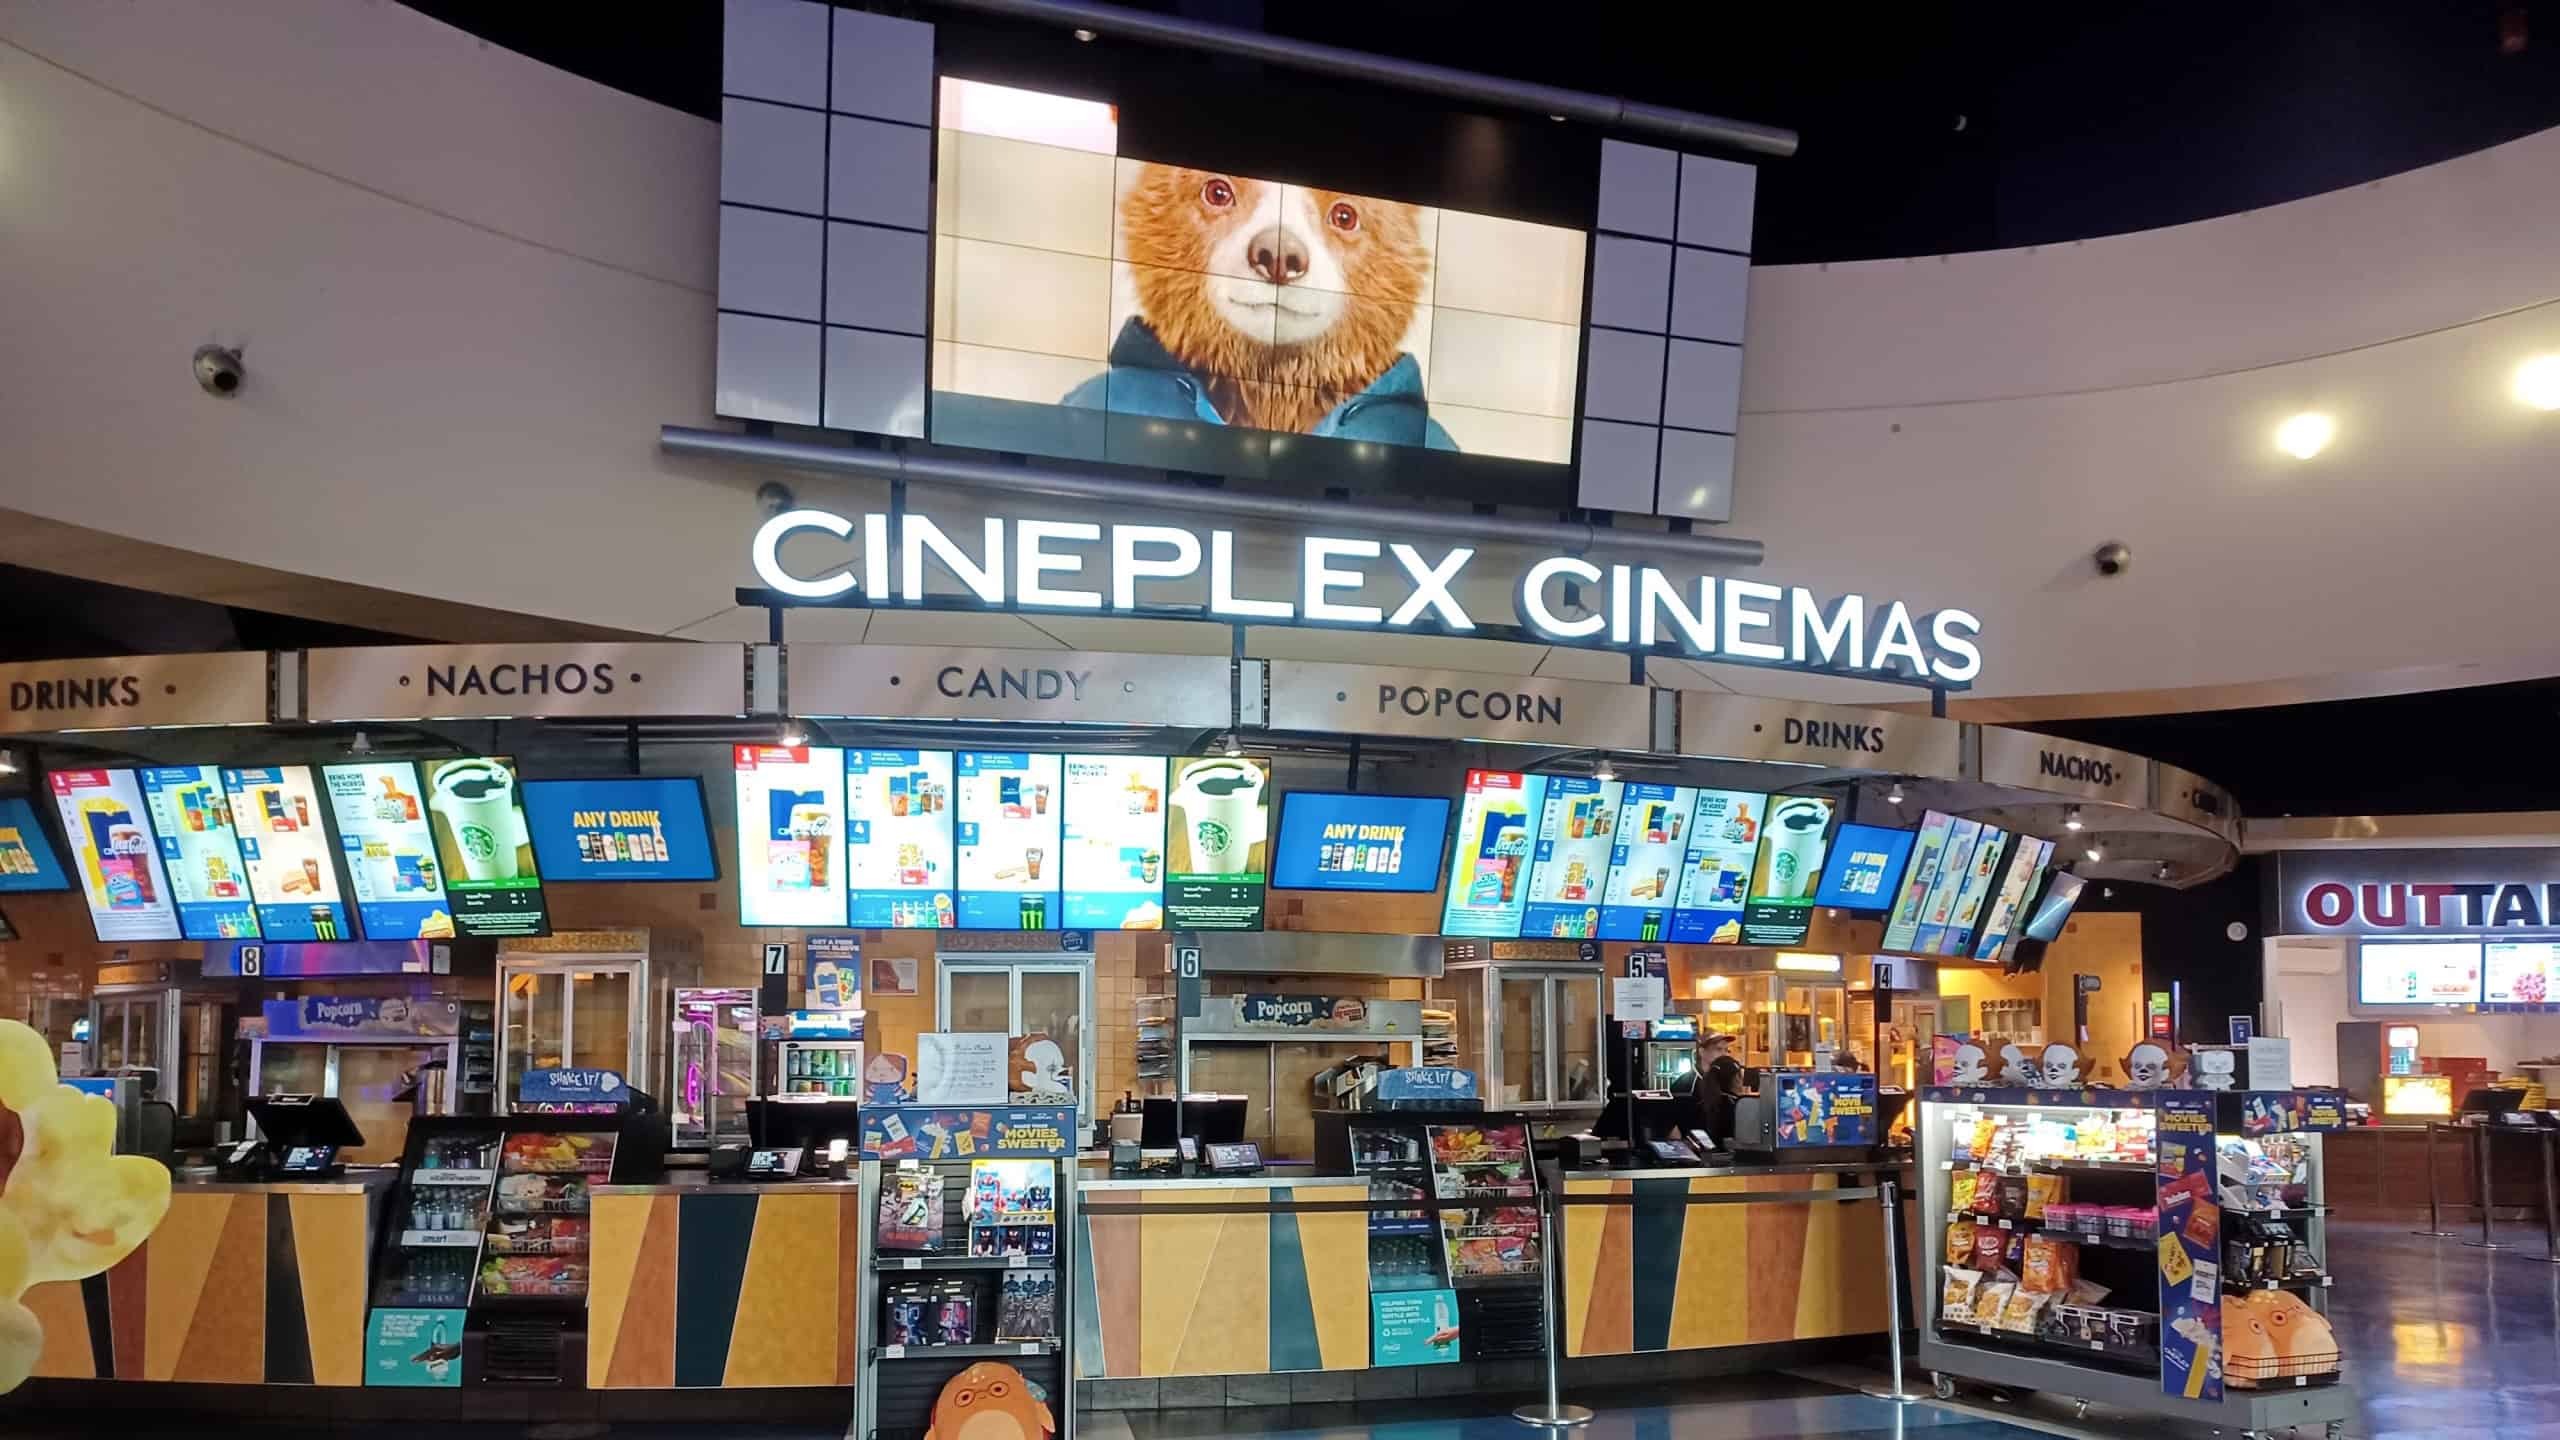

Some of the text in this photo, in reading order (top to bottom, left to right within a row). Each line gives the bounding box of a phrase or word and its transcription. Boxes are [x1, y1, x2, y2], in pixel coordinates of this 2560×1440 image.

[752, 508, 1983, 682] CINEPLEX CINEMAS
[426, 662, 615, 698] NACHOS
[936, 667, 1092, 700] CANDY
[10, 676, 140, 713] DRINKS
[1378, 685, 1562, 726] POPCORN
[1783, 717, 1885, 754] DRINKS
[742, 749, 752, 760] 1
[854, 753, 863, 765] 2
[964, 754, 974, 767] 3
[2040, 751, 2113, 787] NACHOS
[573, 810, 661, 828] ANY DRINK
[854, 822, 865, 834] 4
[964, 823, 974, 836] 5
[1323, 824, 1406, 841] ANY DRINK
[2305, 883, 2560, 927] OUTTA
[244, 948, 258, 975] 8
[767, 946, 782, 972] 7
[1183, 950, 1197, 976] 6
[1631, 954, 1645, 978] 5
[1880, 966, 1889, 988] 4
[317, 1000, 363, 1018] Popcorn
[1257, 999, 1313, 1020] Popcorn
[549, 1071, 600, 1086] SHAKE IT!
[1405, 1071, 1450, 1084] SHAKE IT!
[2164, 1114, 2207, 1123] MOVIES
[997, 1138, 1067, 1150] SWEETER
[1004, 1128, 1059, 1139] MOVIES
